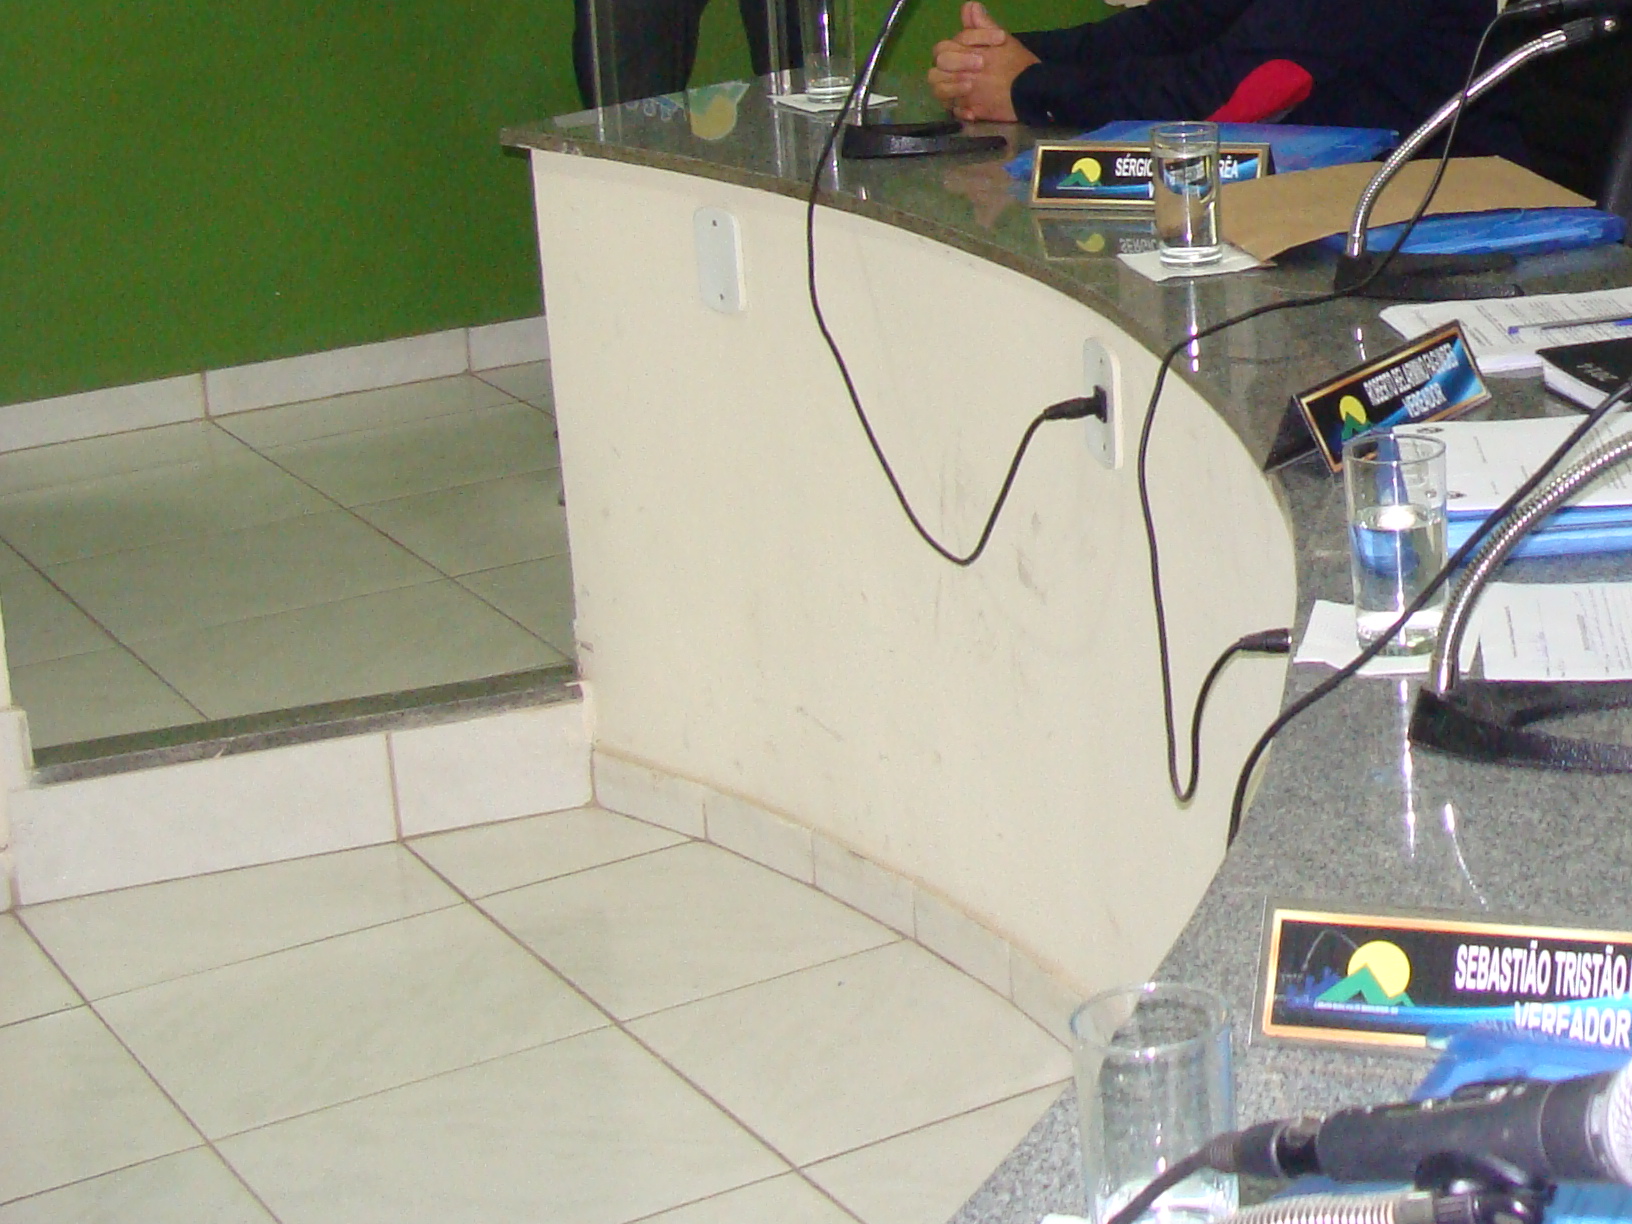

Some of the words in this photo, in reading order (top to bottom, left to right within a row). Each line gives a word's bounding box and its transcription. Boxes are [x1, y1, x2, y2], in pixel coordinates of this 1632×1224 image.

[1455, 940, 1550, 995] SEBASTIÃO
[1555, 945, 1627, 1000] TRISTÃO
[1514, 1000, 1632, 1048] VEREADOR
